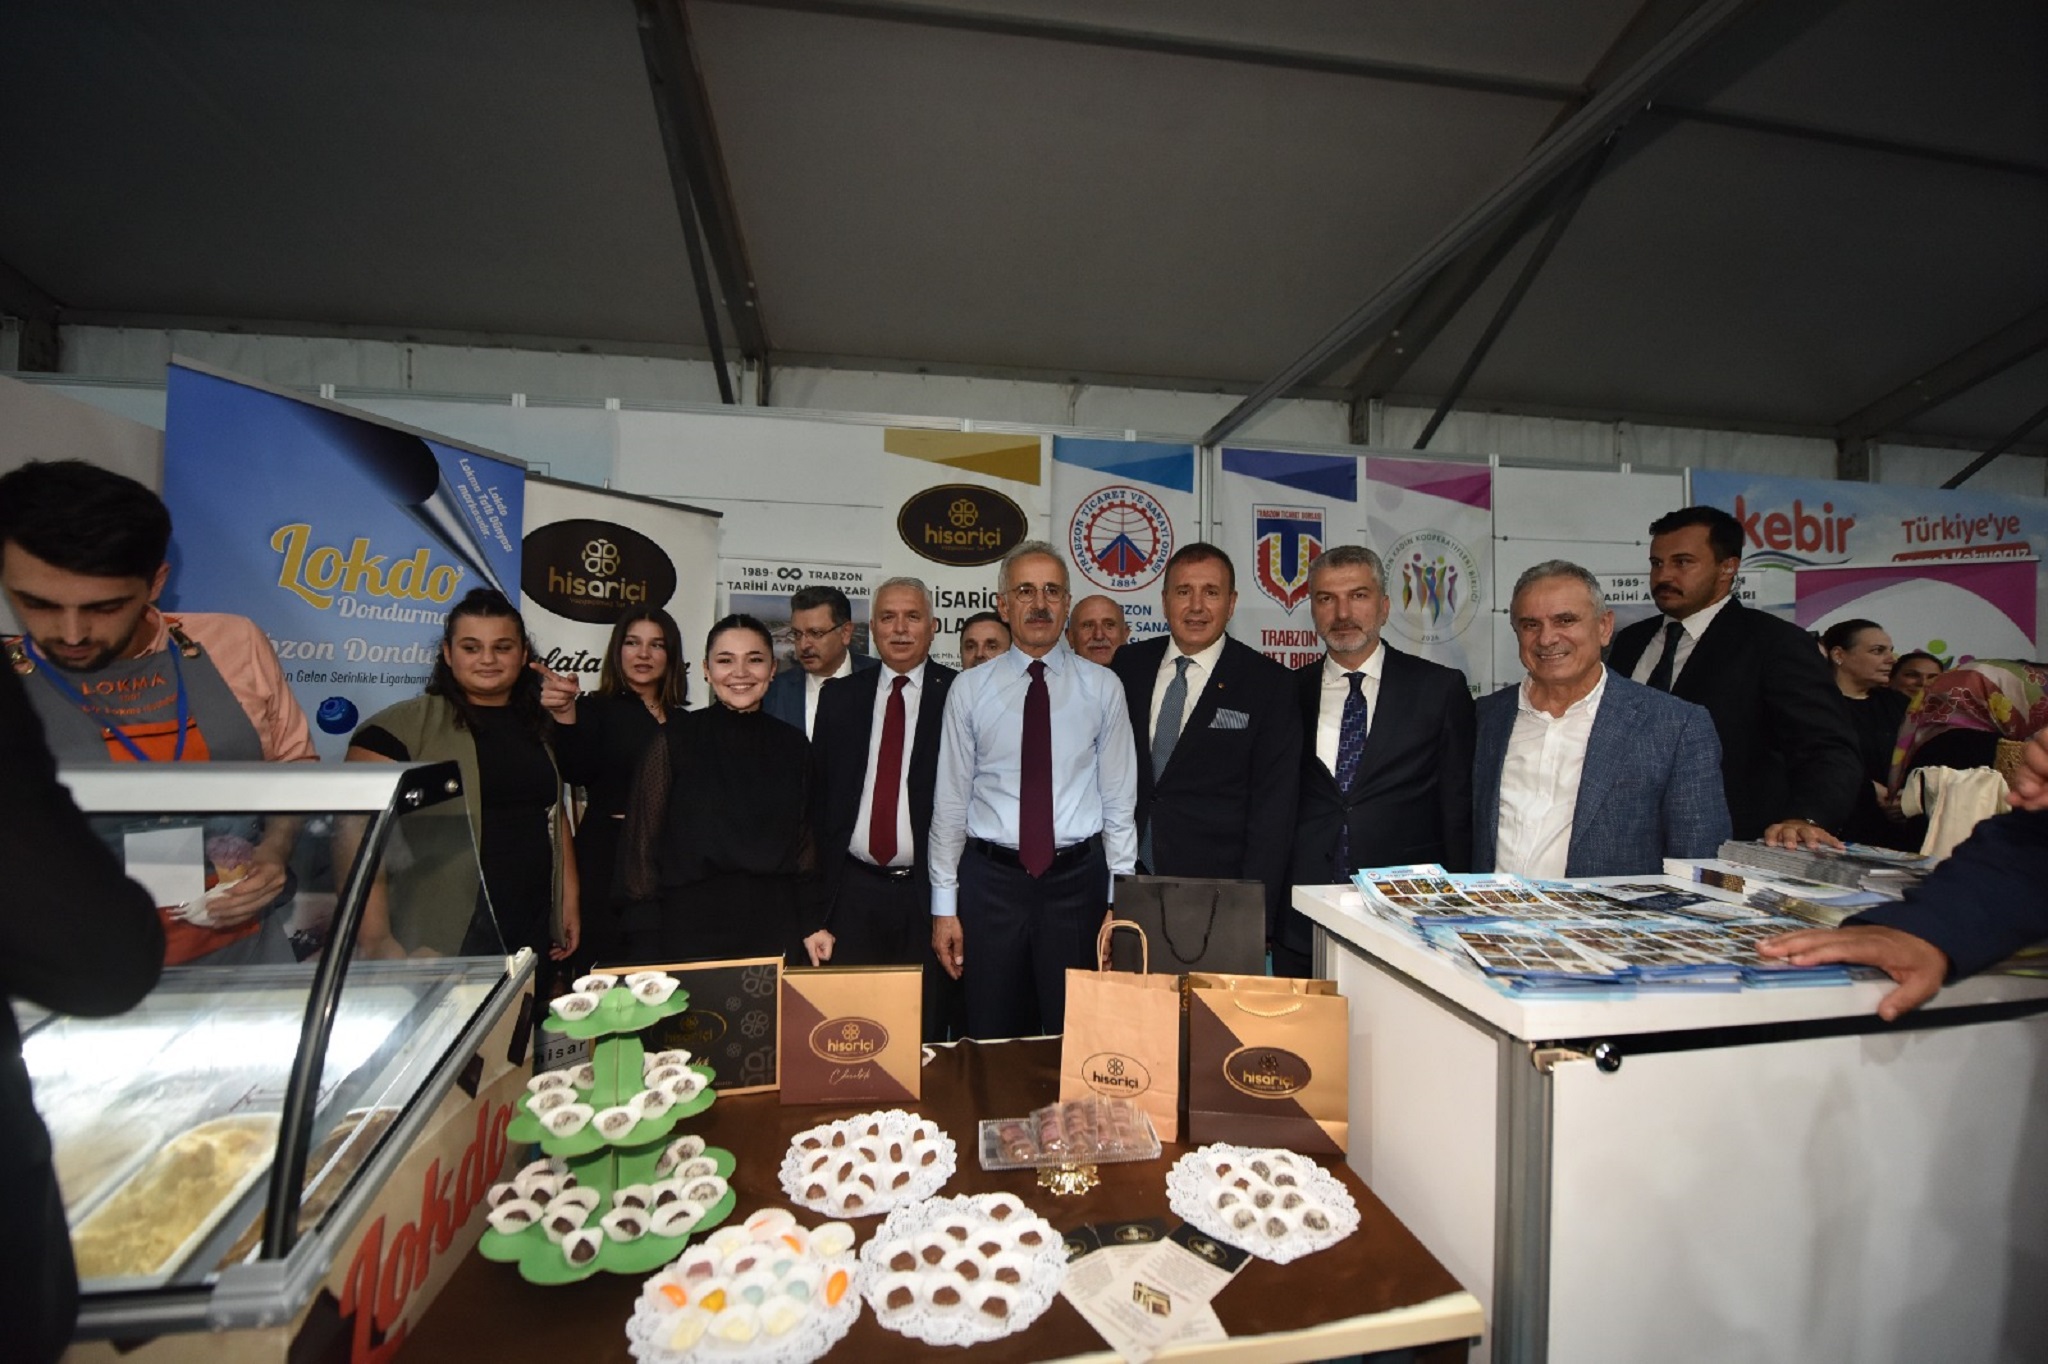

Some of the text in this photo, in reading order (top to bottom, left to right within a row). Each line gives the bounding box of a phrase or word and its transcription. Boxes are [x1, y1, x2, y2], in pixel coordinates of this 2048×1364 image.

[1073, 518, 1093, 574] TRABZON
[1130, 492, 1145, 504] VE
[1735, 494, 1856, 554] kebir
[1901, 512, 2021, 545] Türkiye'ye
[924, 522, 1001, 549] hisariçi
[270, 522, 463, 610] Lokdo
[808, 570, 863, 582] TRABZON
[548, 565, 647, 604] hisariçi
[727, 580, 768, 592] TARİHİ
[1110, 578, 1138, 588] 1884
[930, 586, 998, 611] İSARİÇ
[1604, 590, 1639, 601] ARİHİ
[1260, 629, 1318, 647] TRABZON
[81, 672, 167, 696] LOKMA
[296, 670, 328, 683] Gelen
[330, 671, 378, 684] Serinlikle
[827, 1038, 874, 1054] hisariçi
[1092, 1070, 1139, 1090] hisariçi
[1242, 1070, 1294, 1090] hisariçi
[338, 1099, 514, 1364] Lokdo
